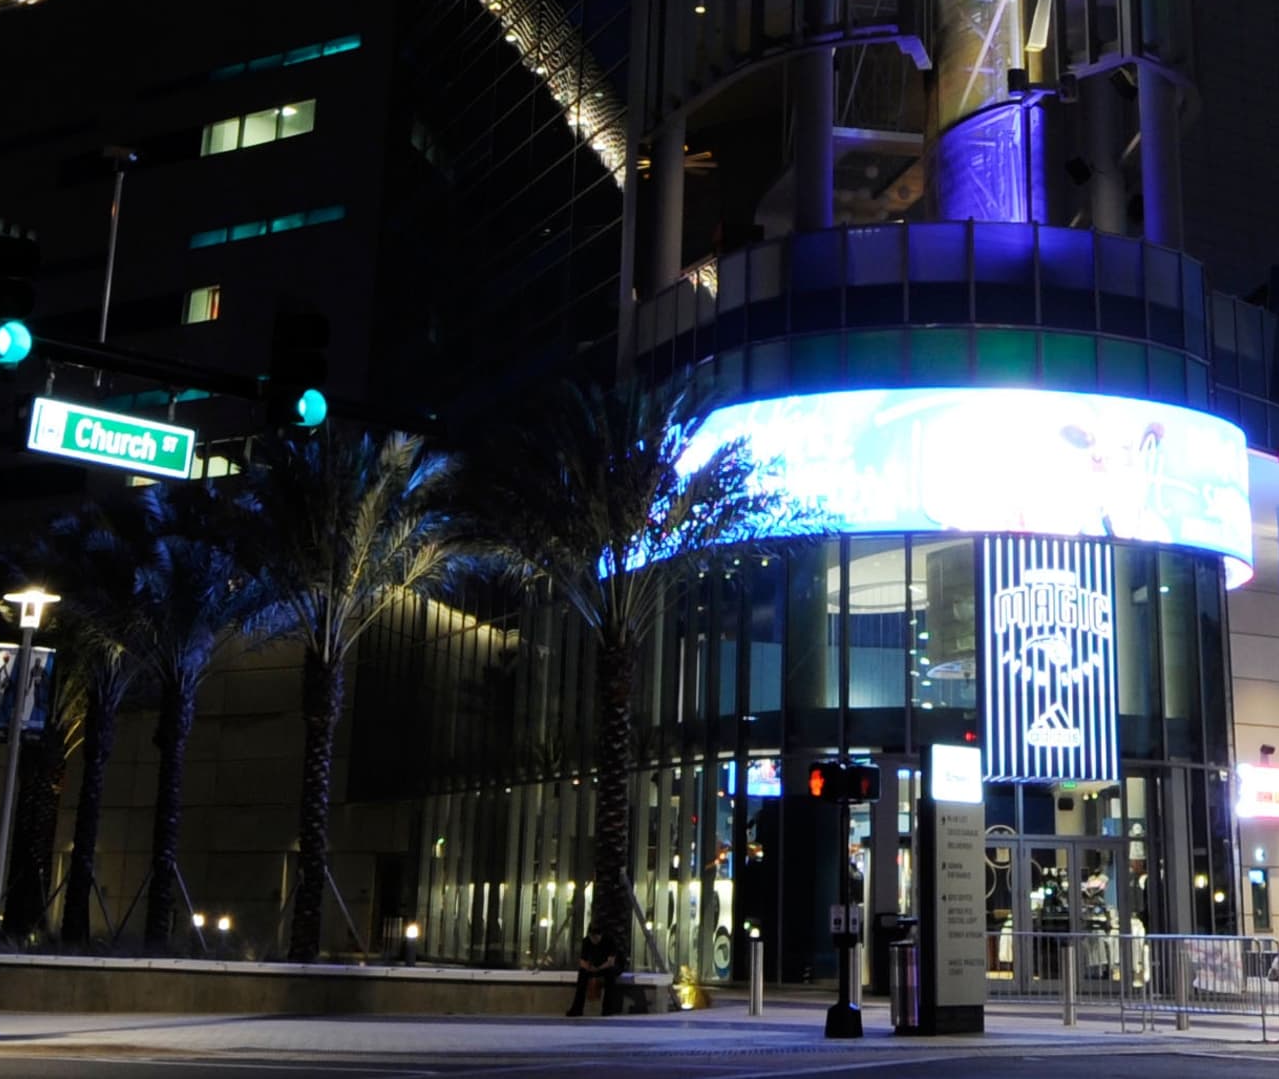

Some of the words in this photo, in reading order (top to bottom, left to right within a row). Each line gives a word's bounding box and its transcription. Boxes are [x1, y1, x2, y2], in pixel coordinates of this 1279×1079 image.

[75, 418, 157, 461] Church
[162, 436, 179, 453] ST
[994, 582, 1111, 639] MAGIC
